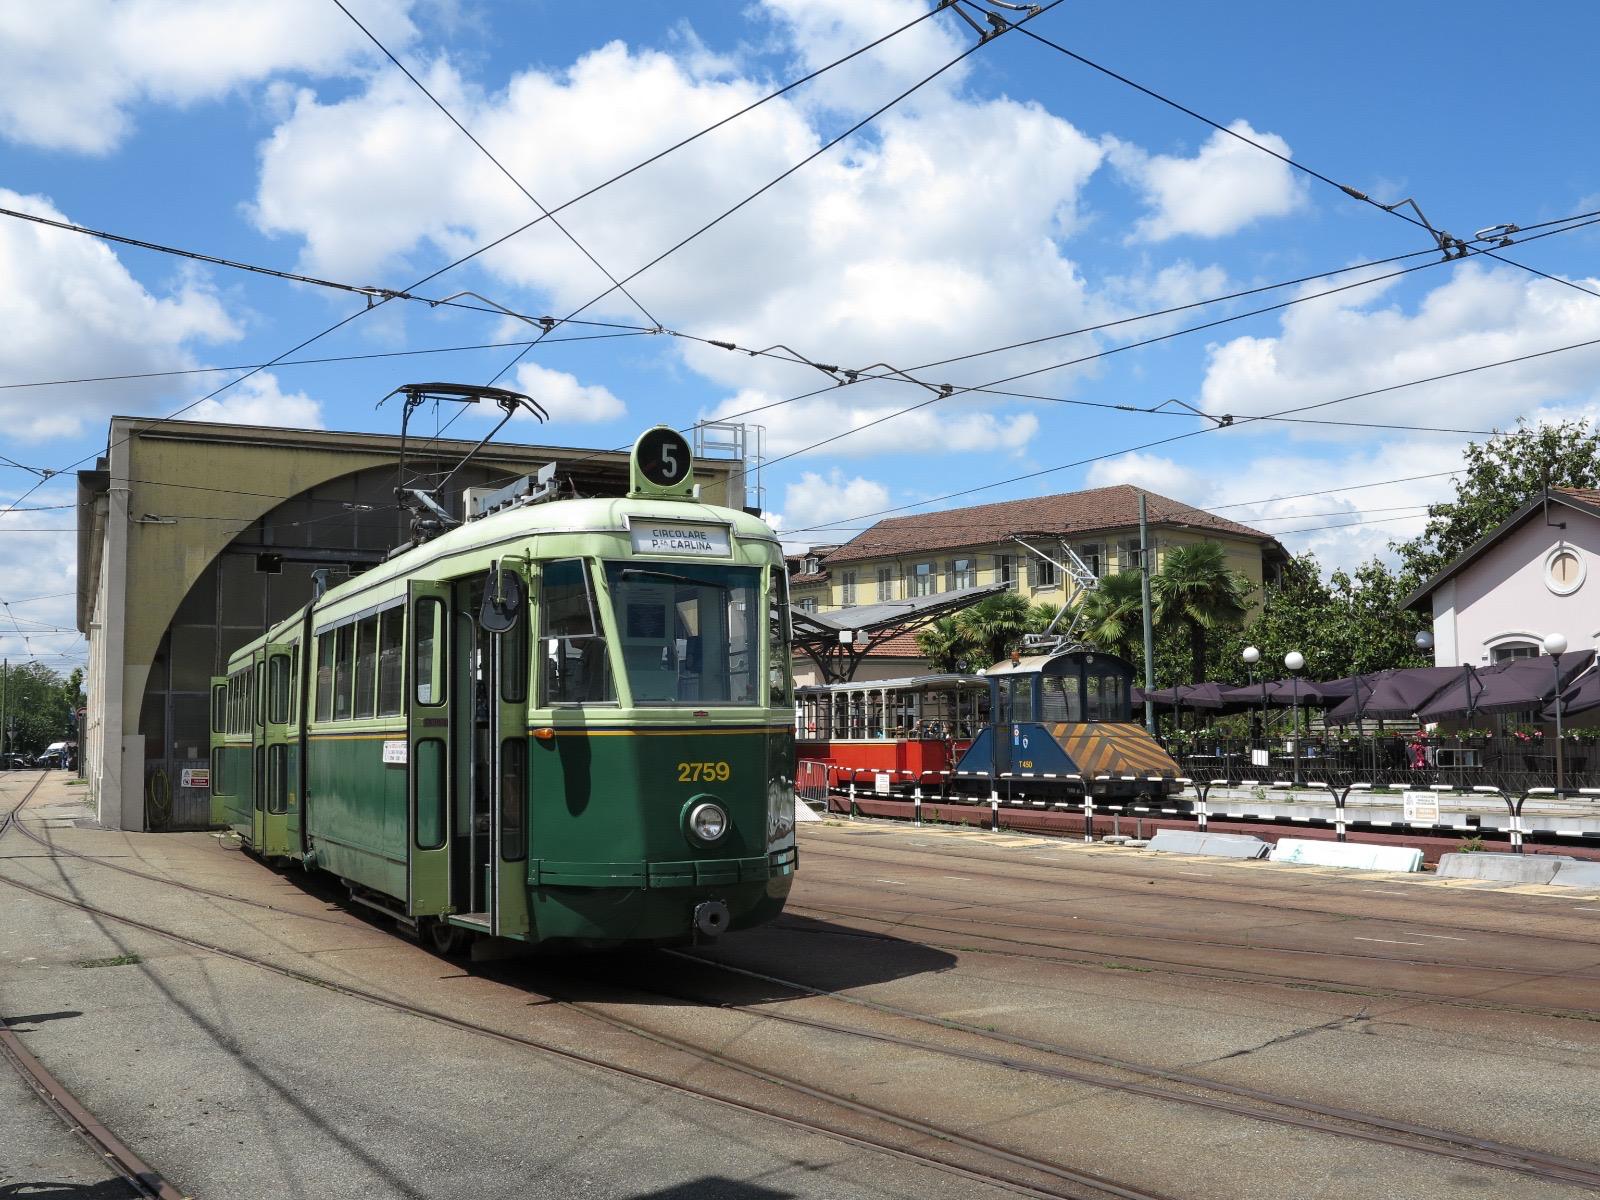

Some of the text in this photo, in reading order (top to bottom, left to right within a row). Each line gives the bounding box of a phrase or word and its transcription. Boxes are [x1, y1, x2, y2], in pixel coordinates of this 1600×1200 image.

[661, 443, 678, 478] 5
[652, 529, 707, 540] CIRCOLARE
[670, 539, 713, 551] CARLINA
[677, 761, 730, 782] 2759
